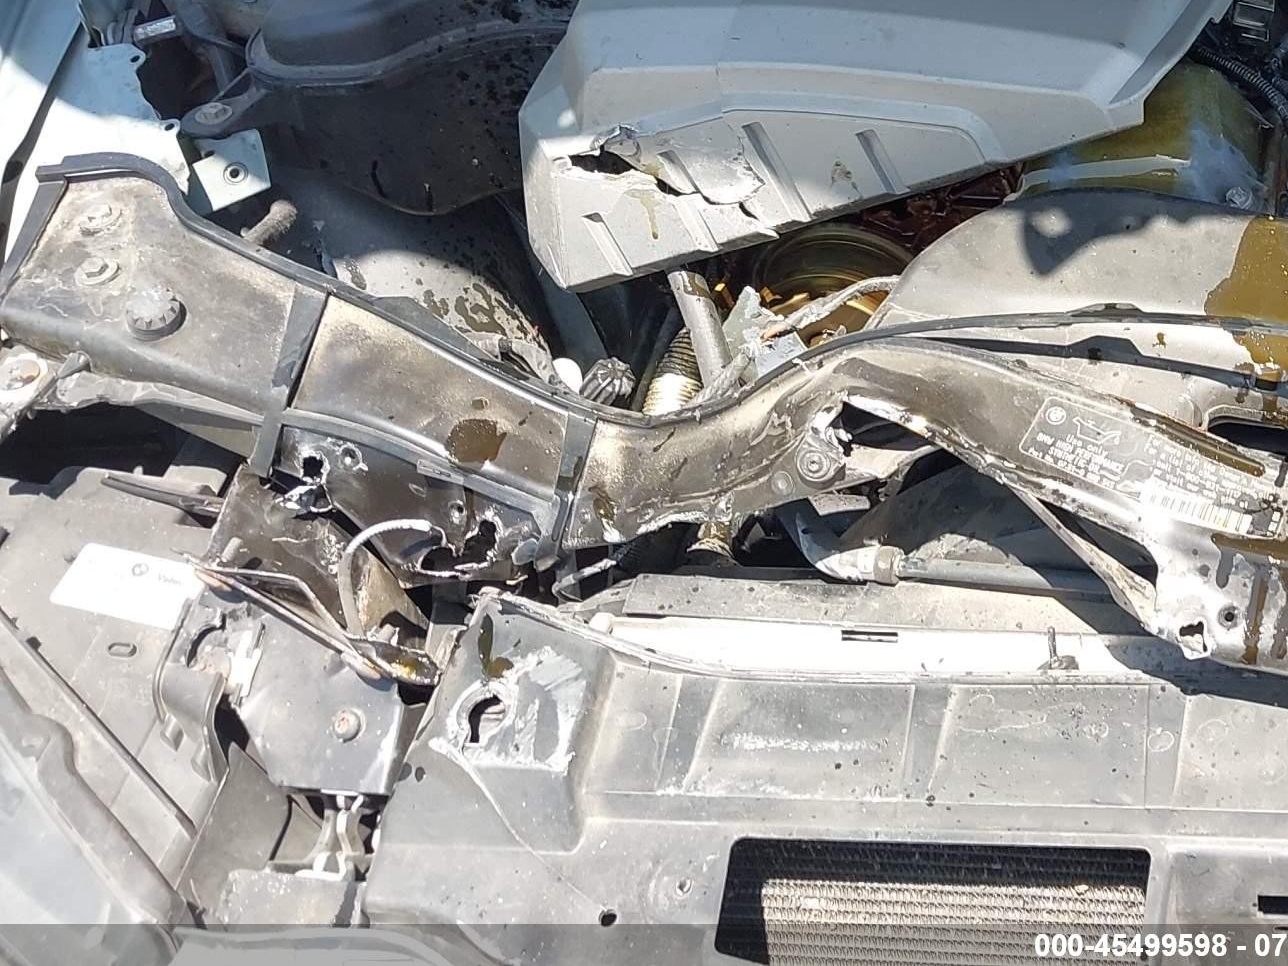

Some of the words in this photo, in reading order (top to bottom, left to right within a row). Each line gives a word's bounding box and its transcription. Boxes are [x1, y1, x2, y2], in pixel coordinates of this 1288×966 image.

[1036, 432, 1055, 445] BMW
[1056, 439, 1074, 454] HIGH
[1066, 433, 1083, 447] Use
[1087, 444, 1109, 457] only
[1144, 443, 1158, 455] For
[1048, 446, 1087, 468] SYNTHETIC
